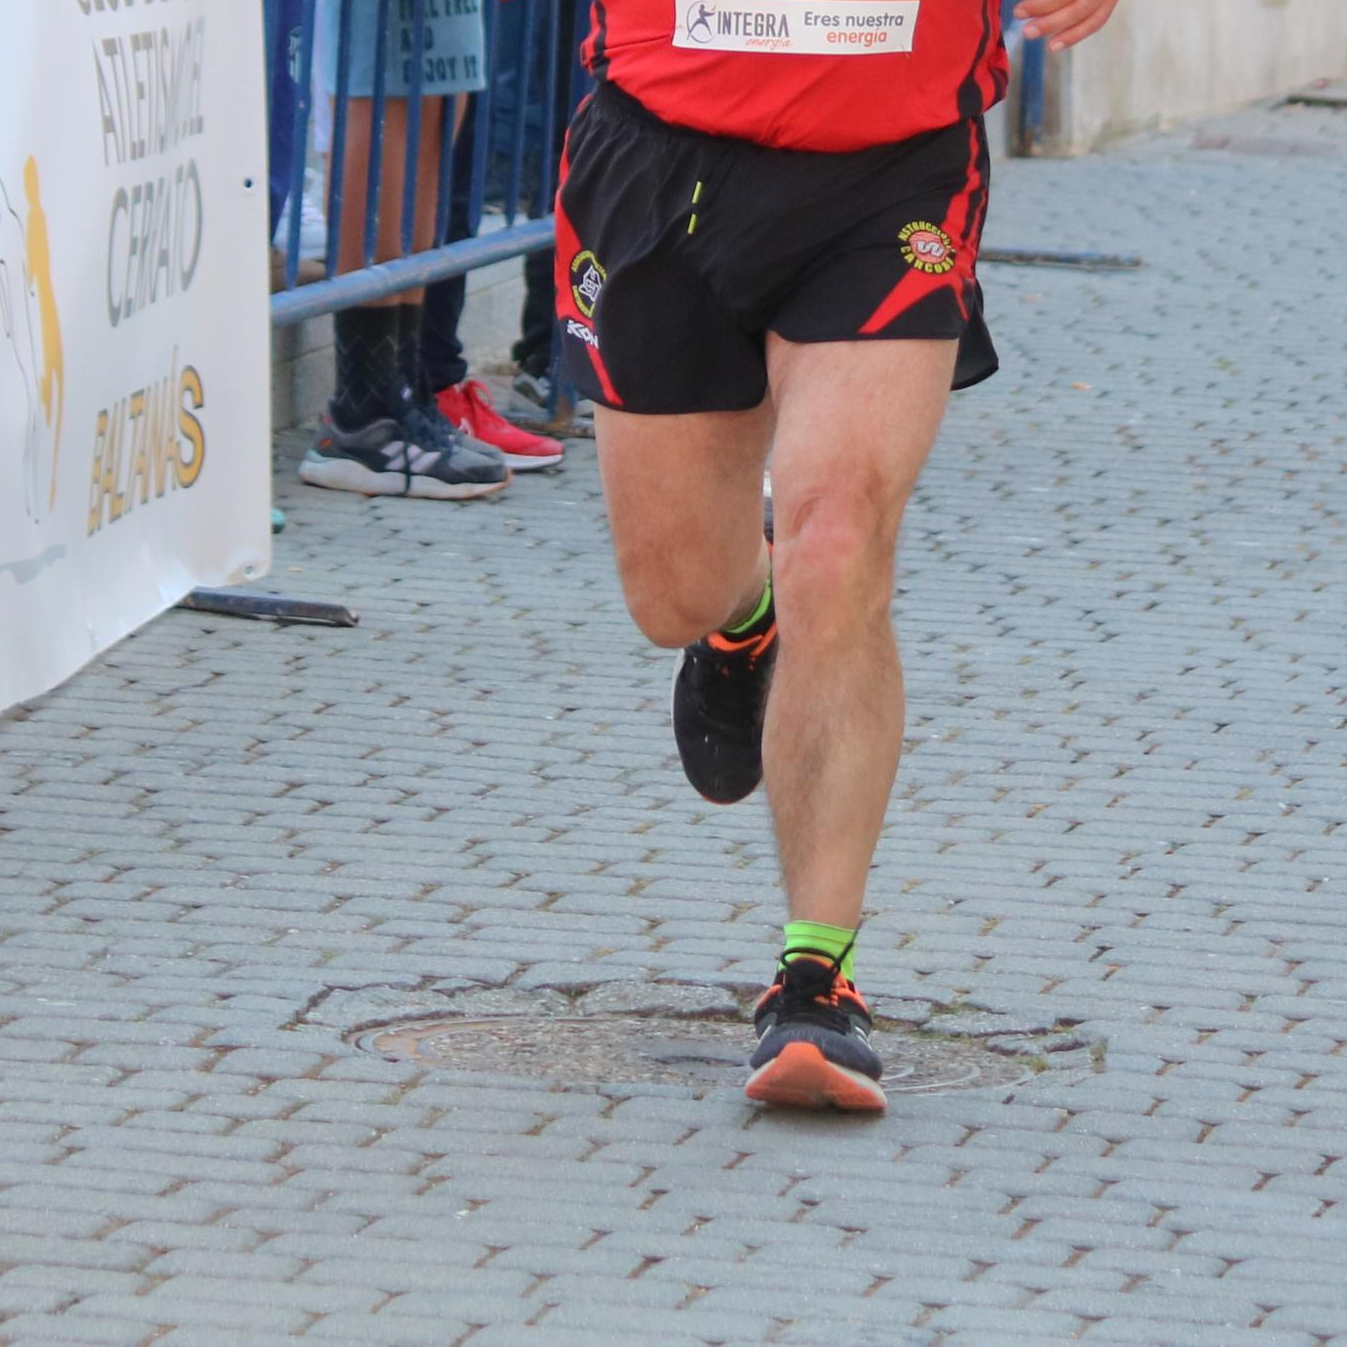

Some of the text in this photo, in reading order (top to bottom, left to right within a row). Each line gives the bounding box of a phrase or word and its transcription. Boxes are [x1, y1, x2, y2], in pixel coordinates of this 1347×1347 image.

[717, 10, 790, 38] INTEGRA
[804, 11, 904, 27] Eres nuestra
[400, 25, 435, 53] AD
[827, 28, 888, 47] energía
[402, 56, 457, 84] EJOY
